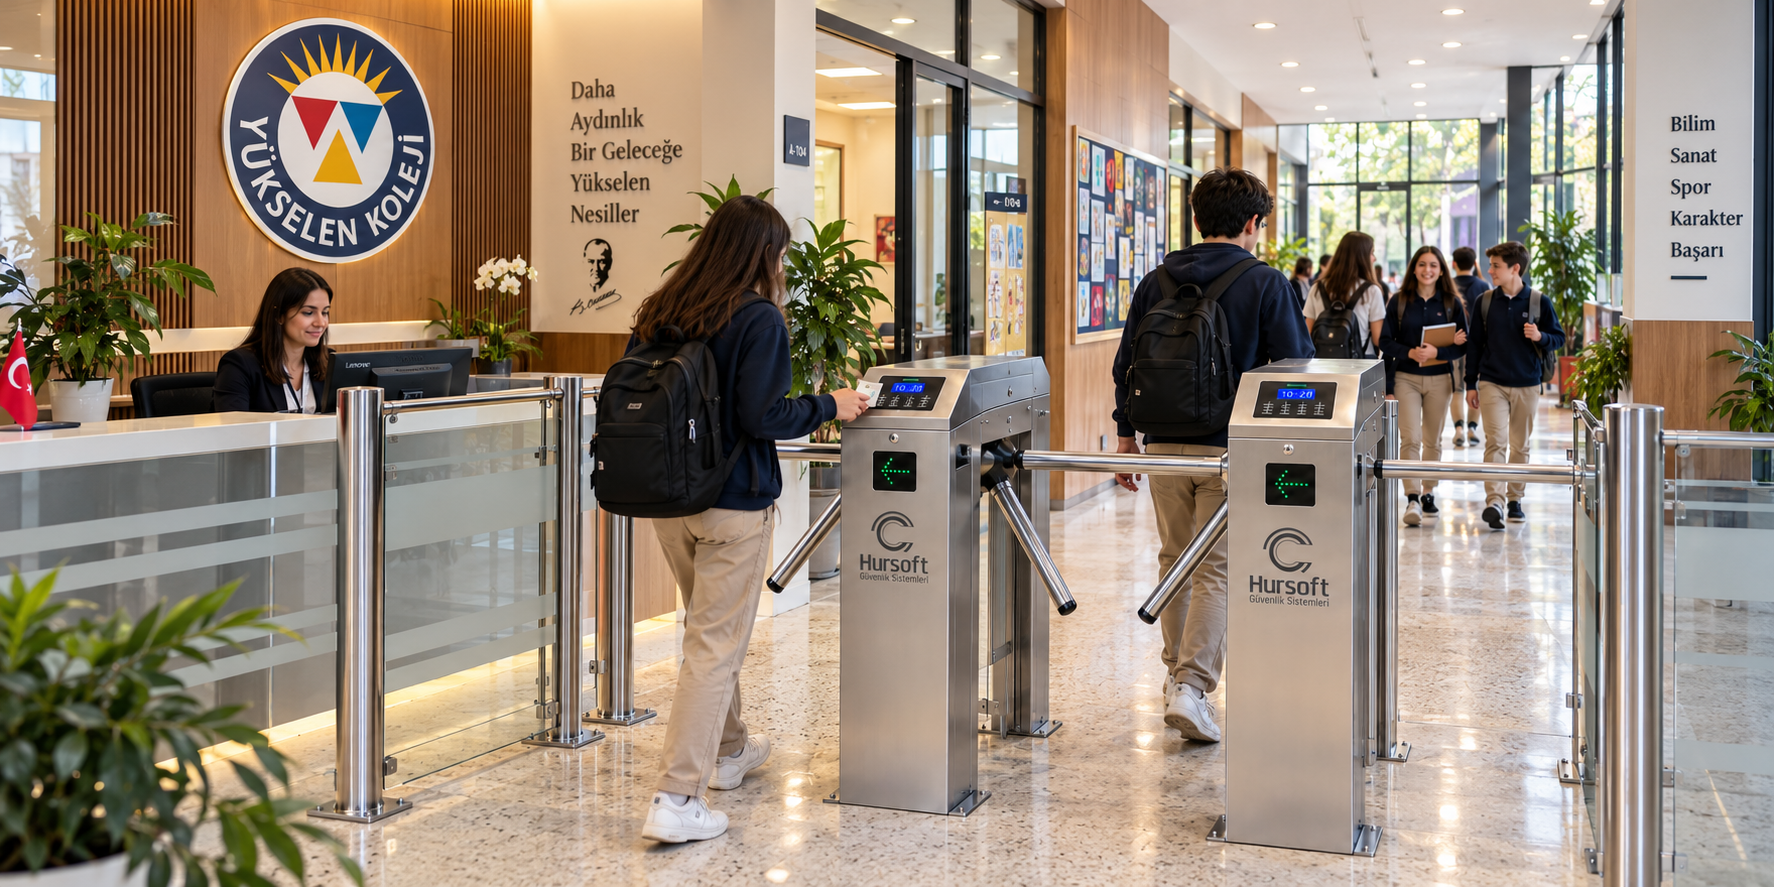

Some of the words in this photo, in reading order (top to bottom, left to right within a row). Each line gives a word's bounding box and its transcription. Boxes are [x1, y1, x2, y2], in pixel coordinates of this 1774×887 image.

[571, 79, 615, 99] Daha
[570, 107, 644, 135] Aydınlık
[1671, 114, 1716, 132] Bilim
[571, 142, 597, 161] Bir
[602, 139, 683, 164] Geleceğe
[1670, 147, 1717, 163] Sanat
[240, 116, 358, 247] YÜKSELEN
[570, 171, 650, 192] Yükselen
[1670, 178, 1712, 200] Spor
[571, 203, 640, 223] Nesiller
[1670, 209, 1744, 226] Karakter
[1671, 242, 1724, 262] Başarı
[859, 553, 929, 574] Hursoft
[859, 572, 890, 581] Güvenlik
[891, 574, 929, 584] Sistemleri
[1249, 575, 1330, 597] Hursoft
[1249, 594, 1285, 605] Güvenlik
[1287, 596, 1330, 607] Sistemleri
